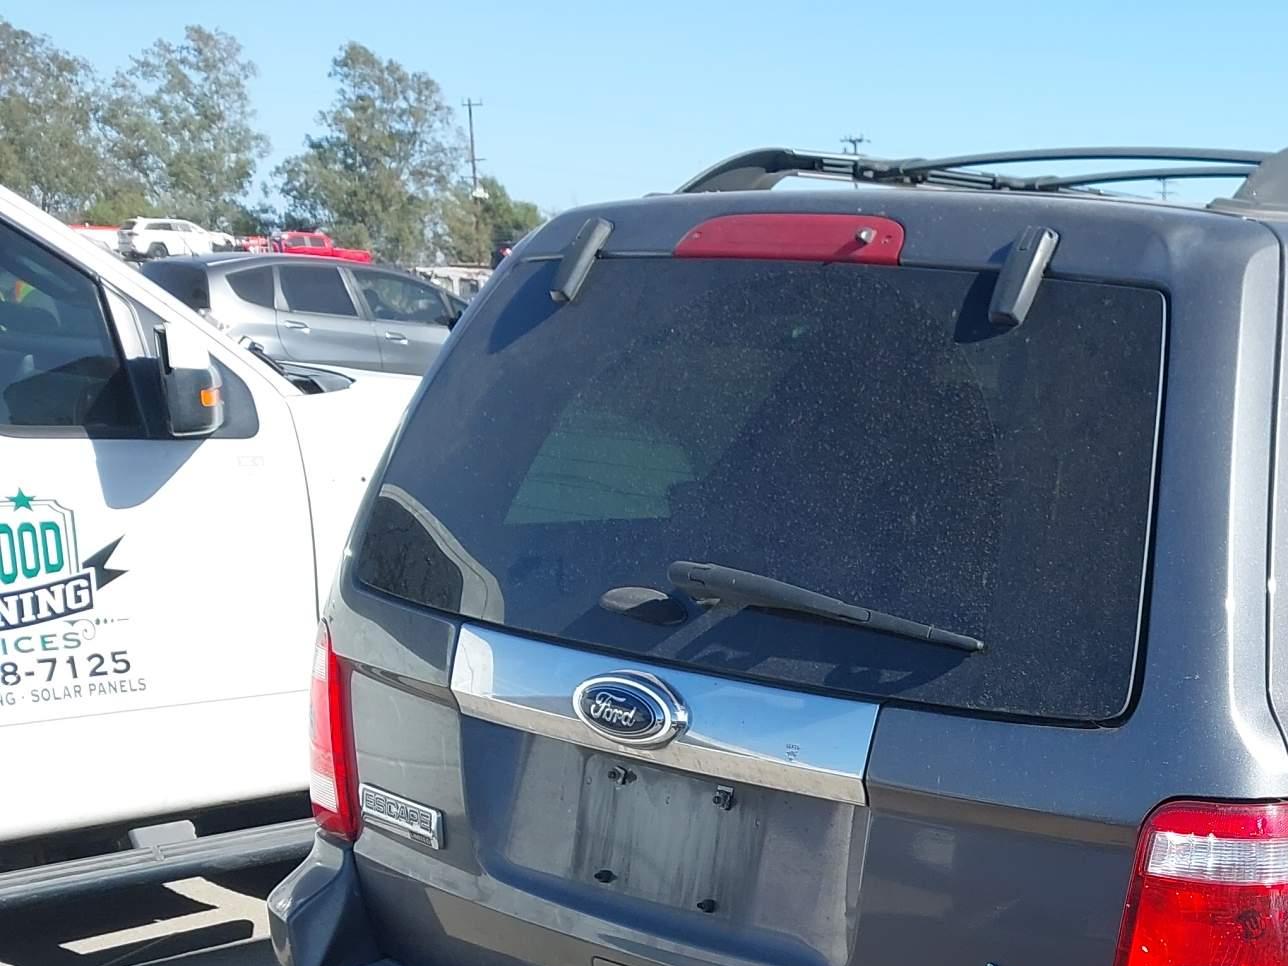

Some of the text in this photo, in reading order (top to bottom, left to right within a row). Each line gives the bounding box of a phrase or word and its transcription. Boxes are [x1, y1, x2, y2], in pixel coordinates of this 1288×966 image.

[1, 632, 81, 656] ICES
[0, 650, 131, 686] 8-7125
[31, 684, 82, 703] SOLAR
[89, 678, 147, 696] PANELS
[591, 691, 636, 727] Ford
[364, 789, 433, 834] ESCAPE
